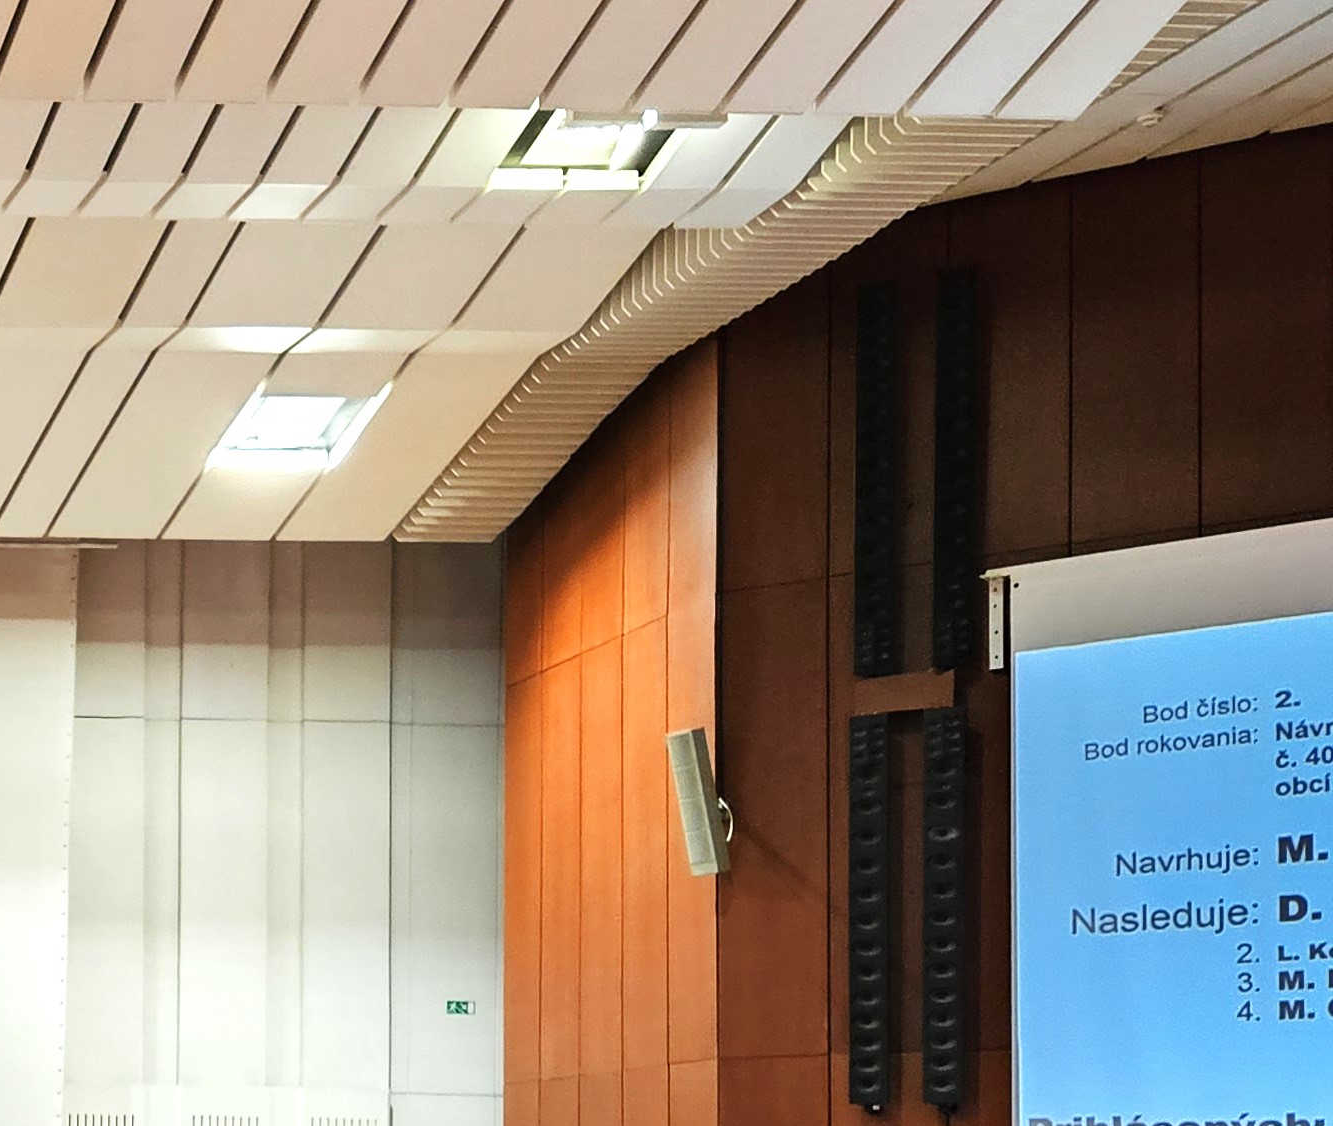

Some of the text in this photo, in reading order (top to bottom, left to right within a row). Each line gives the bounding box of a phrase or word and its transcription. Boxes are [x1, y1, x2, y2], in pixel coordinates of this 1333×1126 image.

[1142, 689, 1302, 724] Bod číslo: 2.
[1084, 718, 1333, 761] Bod rokovania: Návr
[1275, 748, 1297, 769] č.
[1275, 772, 1331, 796] obcí
[1115, 833, 1329, 876] Navrhuje: M.
[1071, 894, 1323, 935] Nasleduje: D.
[1236, 943, 1260, 964] 2.
[1277, 945, 1300, 962] L.
[1237, 971, 1260, 993] 3.
[1278, 970, 1315, 991] M.
[1236, 1000, 1261, 1021] 4.
[1279, 999, 1315, 1020] M.
